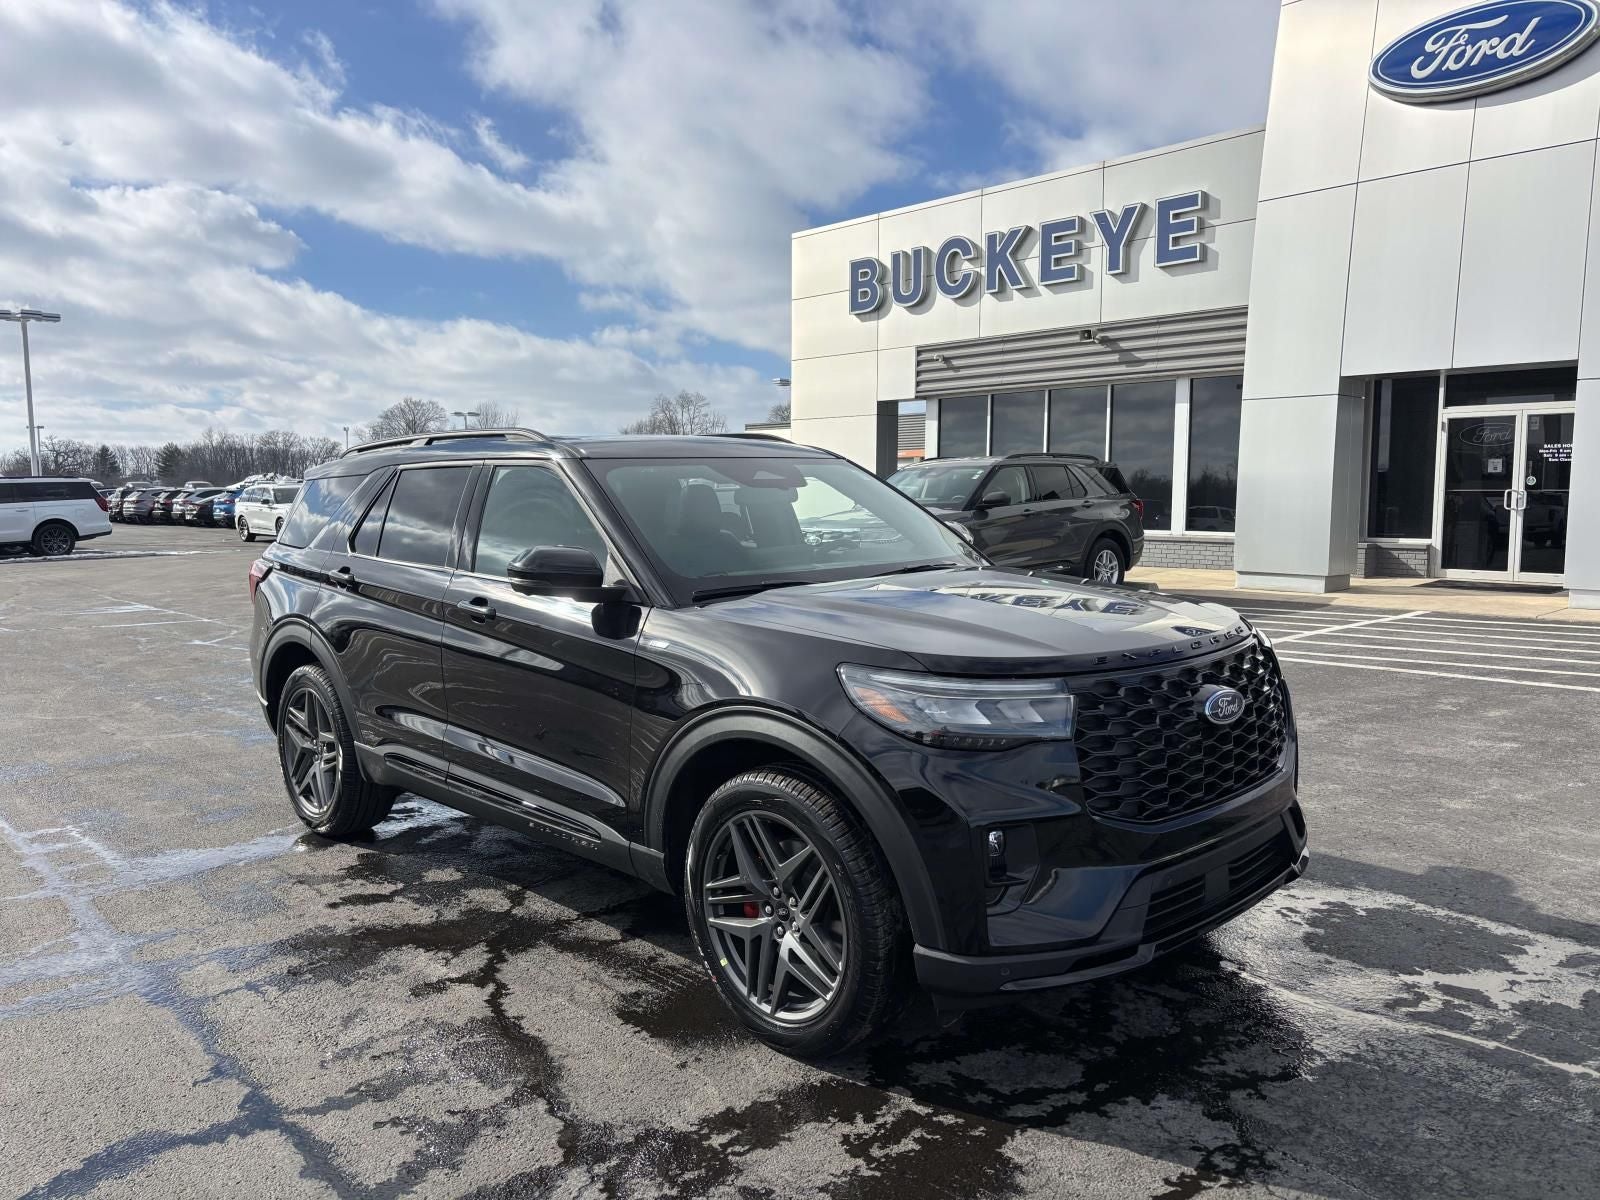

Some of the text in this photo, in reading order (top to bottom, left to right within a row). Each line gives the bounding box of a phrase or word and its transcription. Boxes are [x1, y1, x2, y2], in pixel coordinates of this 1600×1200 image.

[1410, 15, 1542, 79] Ford
[849, 190, 1206, 315] BUCKEYE
[1472, 426, 1512, 443] Ford
[1092, 626, 1244, 665] EXPLORER
[1218, 697, 1239, 718] Ford
